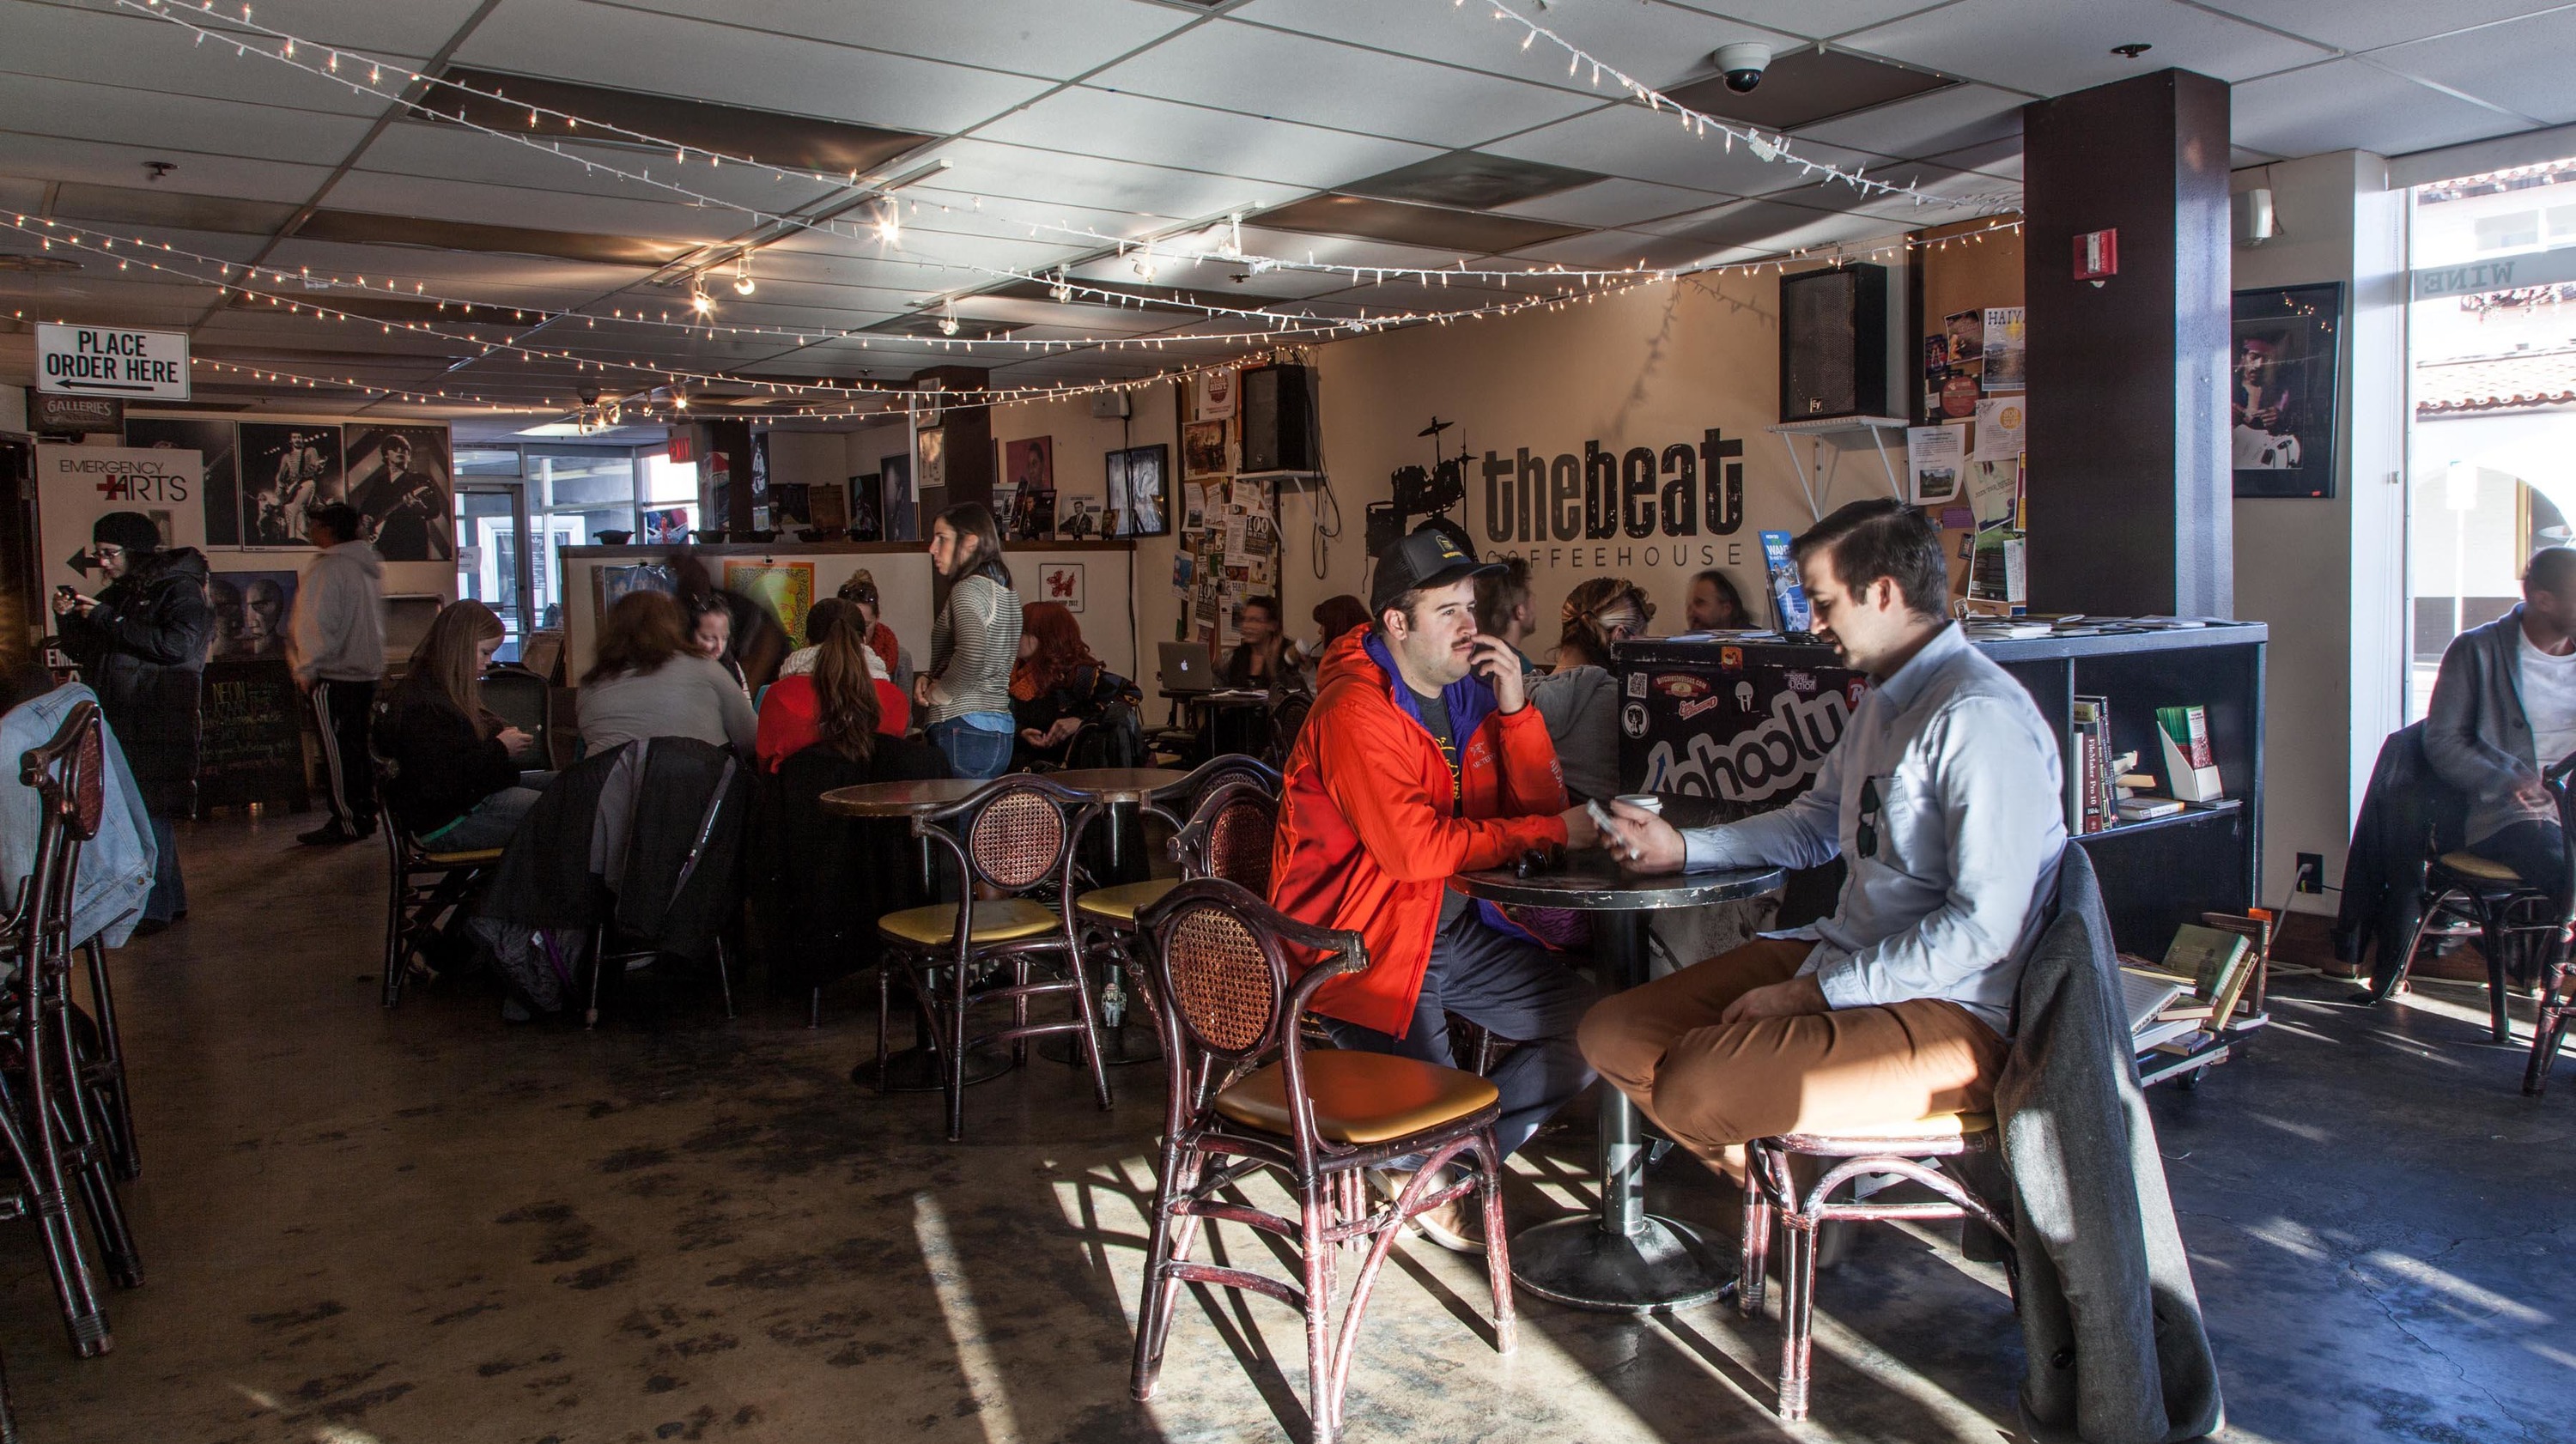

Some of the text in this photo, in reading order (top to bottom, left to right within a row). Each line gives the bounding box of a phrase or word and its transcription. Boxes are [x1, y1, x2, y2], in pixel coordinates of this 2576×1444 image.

[1988, 311, 2025, 325] HAIY
[78, 331, 146, 356] PLACE
[46, 354, 179, 383] ORDER HERE
[47, 400, 112, 416] GALLERIES
[60, 460, 164, 473] EMERGENCY
[106, 476, 187, 501] ARTS
[1248, 516, 1268, 533] 100
[1199, 583, 1216, 600] 100
[2088, 738, 2097, 779] FileMaker
